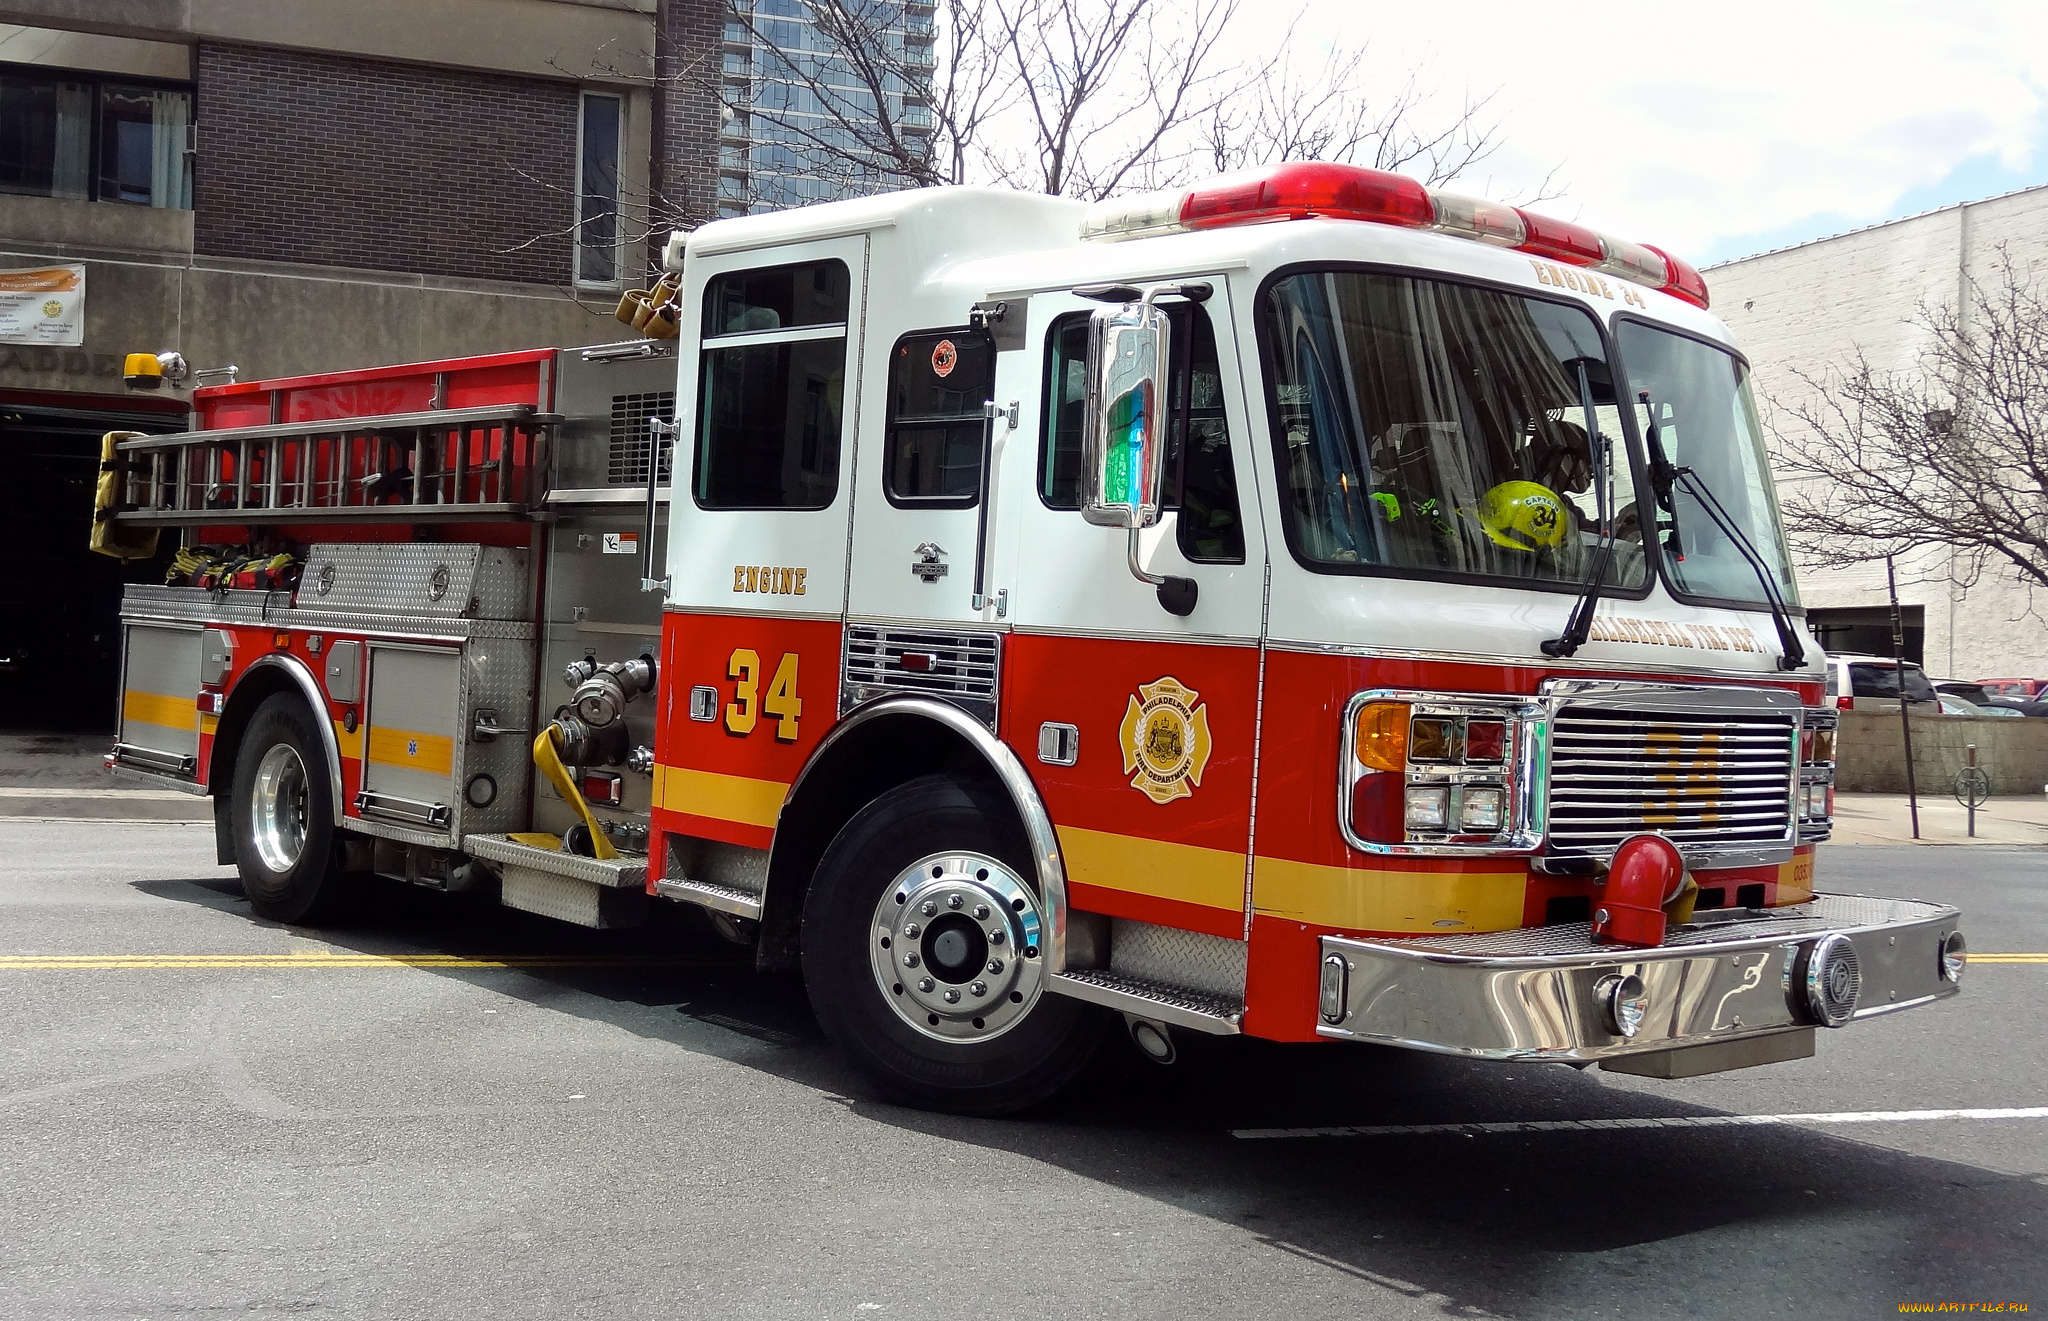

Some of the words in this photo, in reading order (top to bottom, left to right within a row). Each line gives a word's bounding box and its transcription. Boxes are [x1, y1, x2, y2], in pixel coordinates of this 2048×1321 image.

[1529, 260, 1614, 300] ENGINE
[1617, 281, 1646, 309] 34
[0, 352, 118, 376] ADDE
[1525, 496, 1559, 513] CAPTAIN
[1533, 505, 1557, 529] 34
[733, 565, 808, 596] ENGINE
[1591, 615, 1694, 648] HILADELPHIA
[1685, 624, 1729, 651] FIRE
[723, 648, 802, 745] 34
[1142, 697, 1192, 722] PHILADELPHIA
[1135, 752, 1149, 773] FIRE
[1147, 759, 1192, 783] DEPARTMENT
